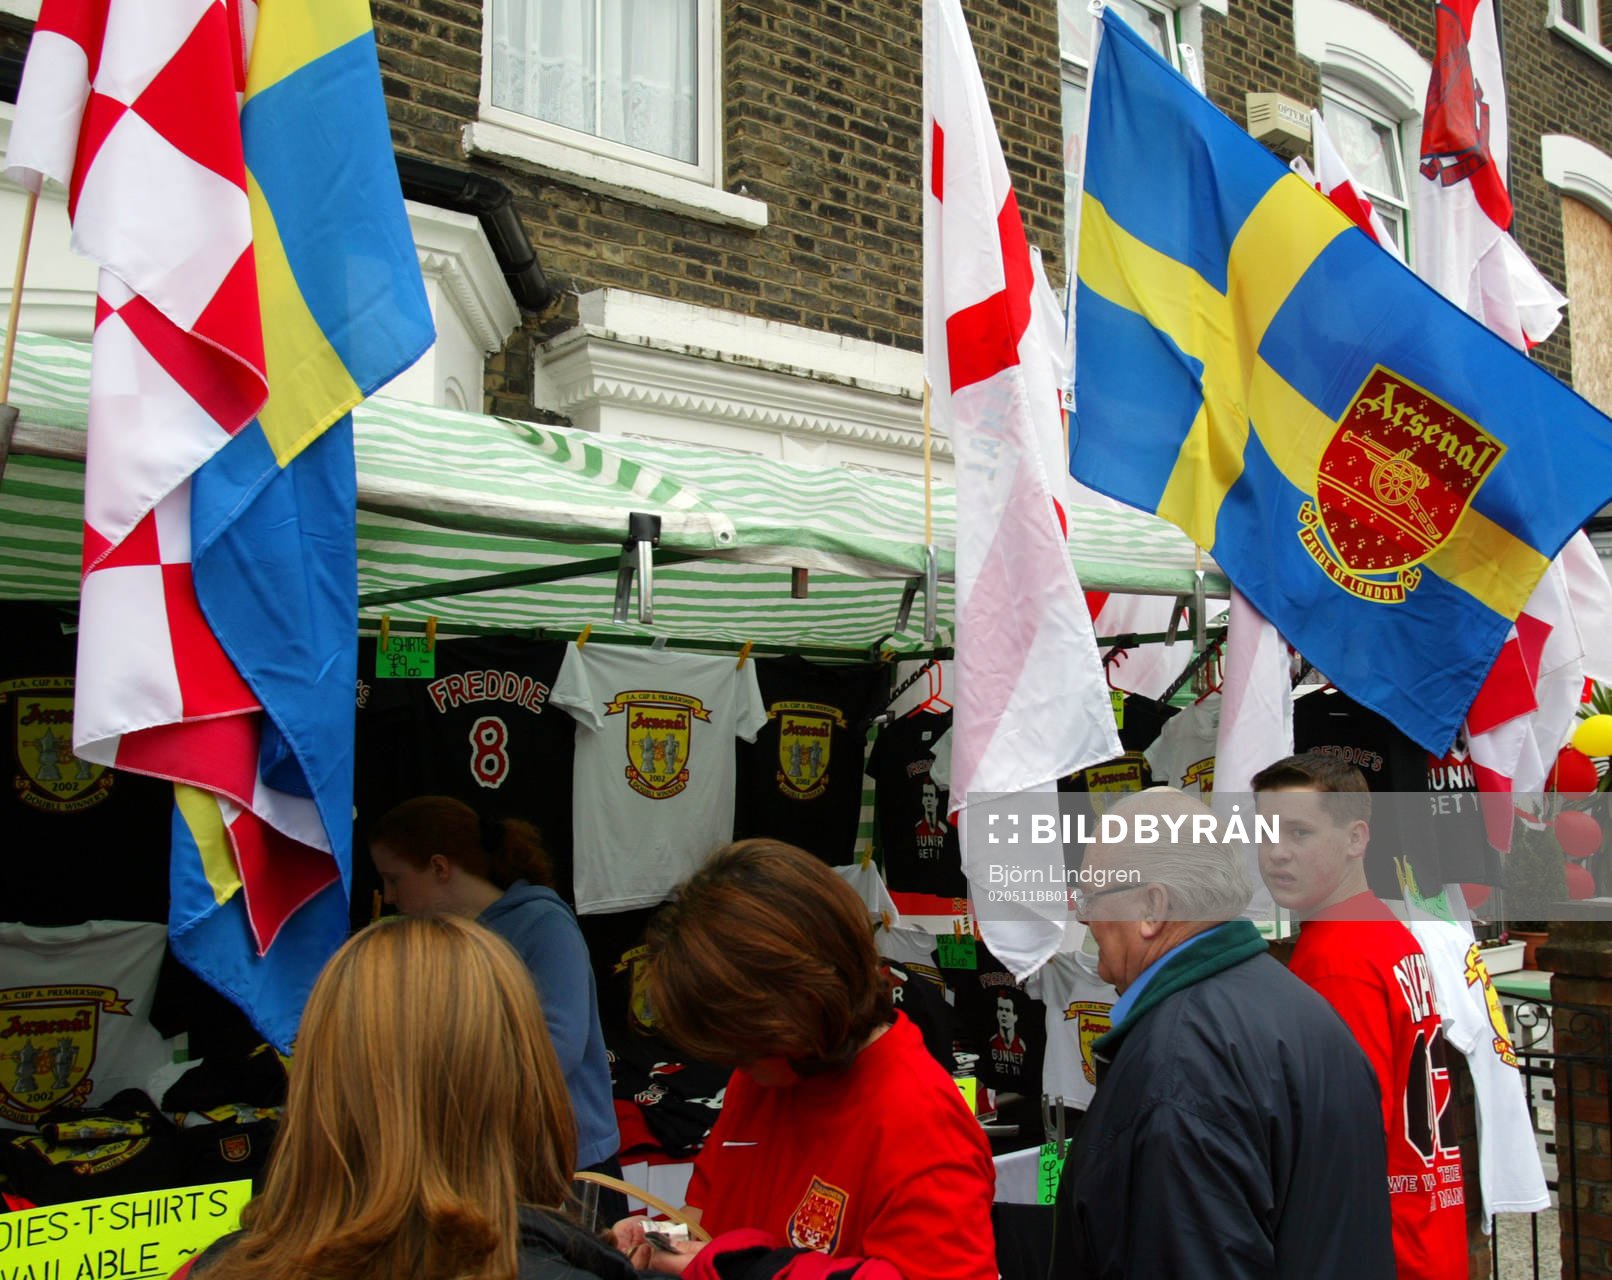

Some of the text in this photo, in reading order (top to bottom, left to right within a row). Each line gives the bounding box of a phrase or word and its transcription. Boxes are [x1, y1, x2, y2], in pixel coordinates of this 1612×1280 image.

[1356, 382, 1496, 477] Arsenal
[1303, 532, 1399, 600] PRIDE OF LONDON
[427, 669, 549, 715] FREDDIE
[469, 716, 509, 789] 8
[52, 782, 79, 792] 2002
[15, 991, 33, 999] CUP
[27, 1092, 54, 1102] 2002
[1388, 1175, 1417, 1193] WE
